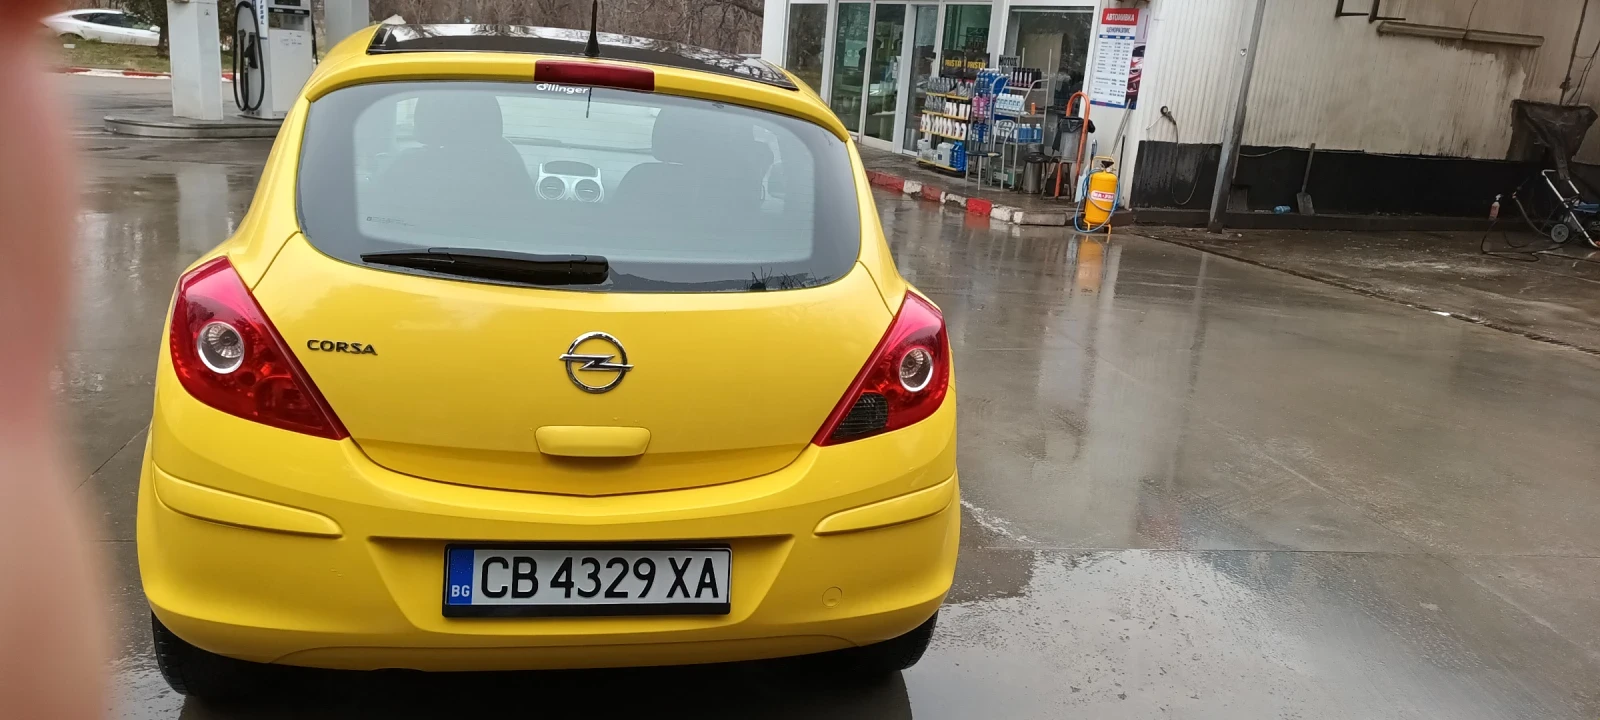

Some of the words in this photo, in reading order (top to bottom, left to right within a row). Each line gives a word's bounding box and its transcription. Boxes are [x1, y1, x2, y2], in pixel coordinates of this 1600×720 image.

[1105, 13, 1135, 22] АВТОМИВКА
[306, 338, 378, 356] CORSA
[481, 556, 539, 599] CB
[549, 557, 657, 599] 4329
[665, 557, 719, 599] XA
[451, 585, 470, 598] BG
